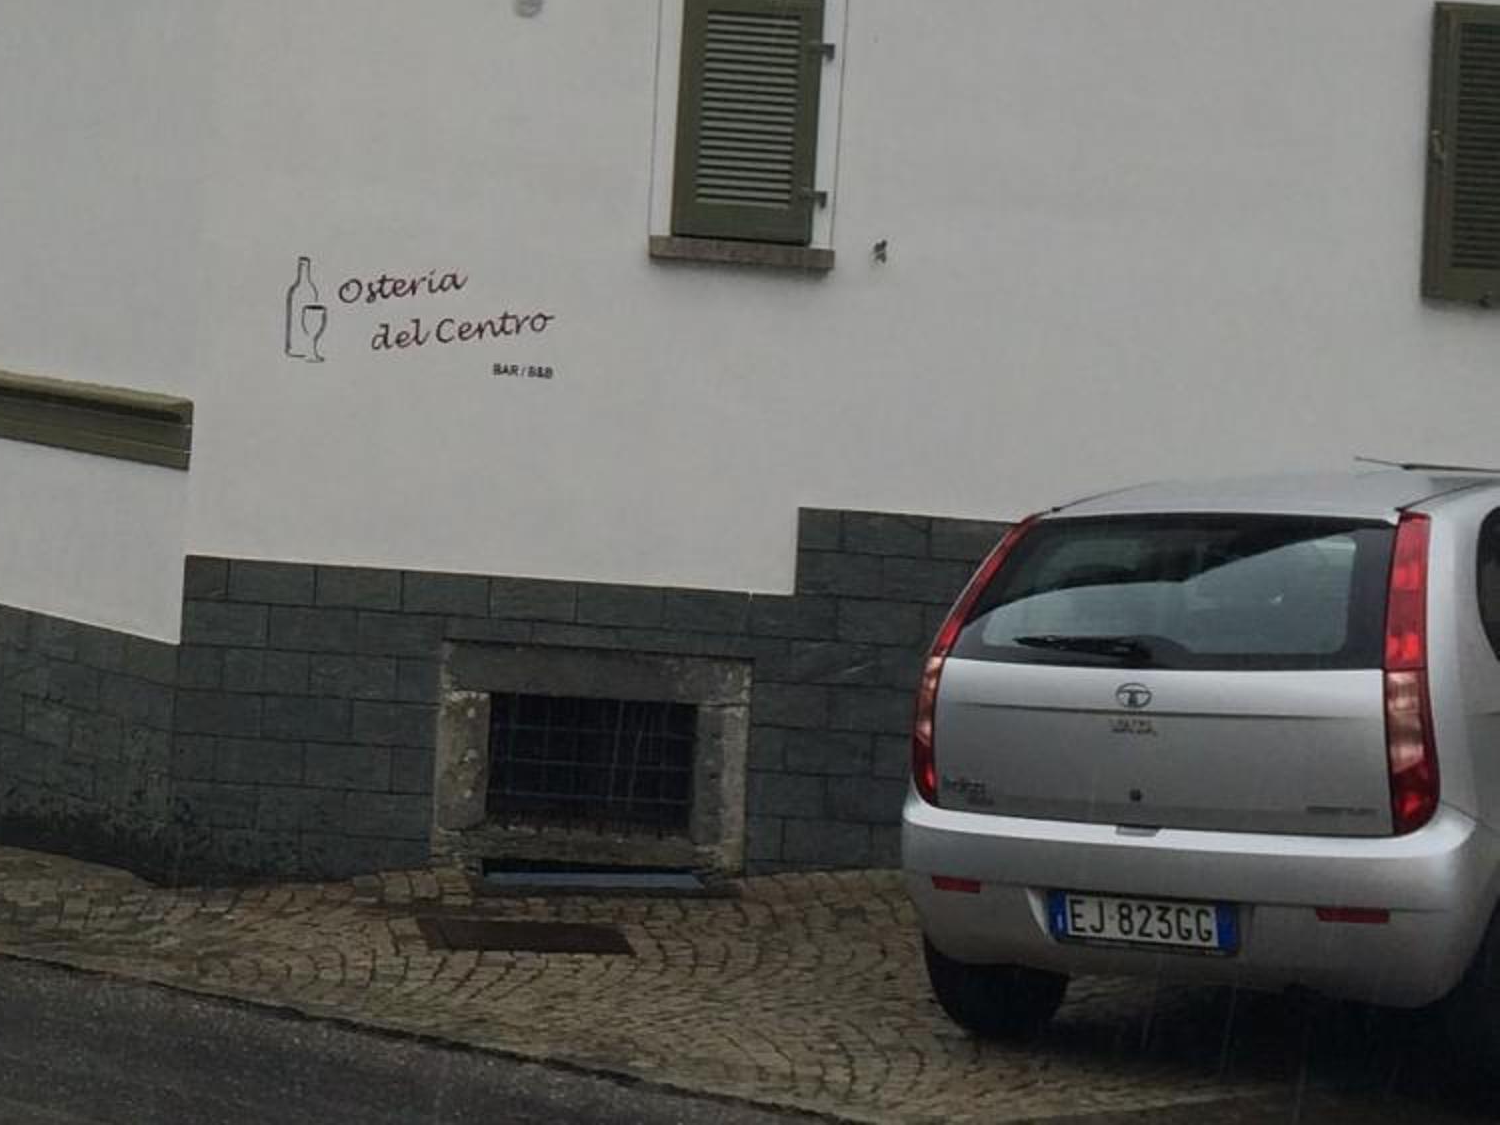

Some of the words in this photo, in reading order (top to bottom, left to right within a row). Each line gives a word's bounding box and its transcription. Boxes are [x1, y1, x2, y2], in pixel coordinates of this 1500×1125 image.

[338, 269, 469, 304] Osteria
[371, 320, 430, 351] del
[435, 310, 555, 344] Centro
[1069, 898, 1105, 934] EJ
[1117, 903, 1213, 942] 823GG
